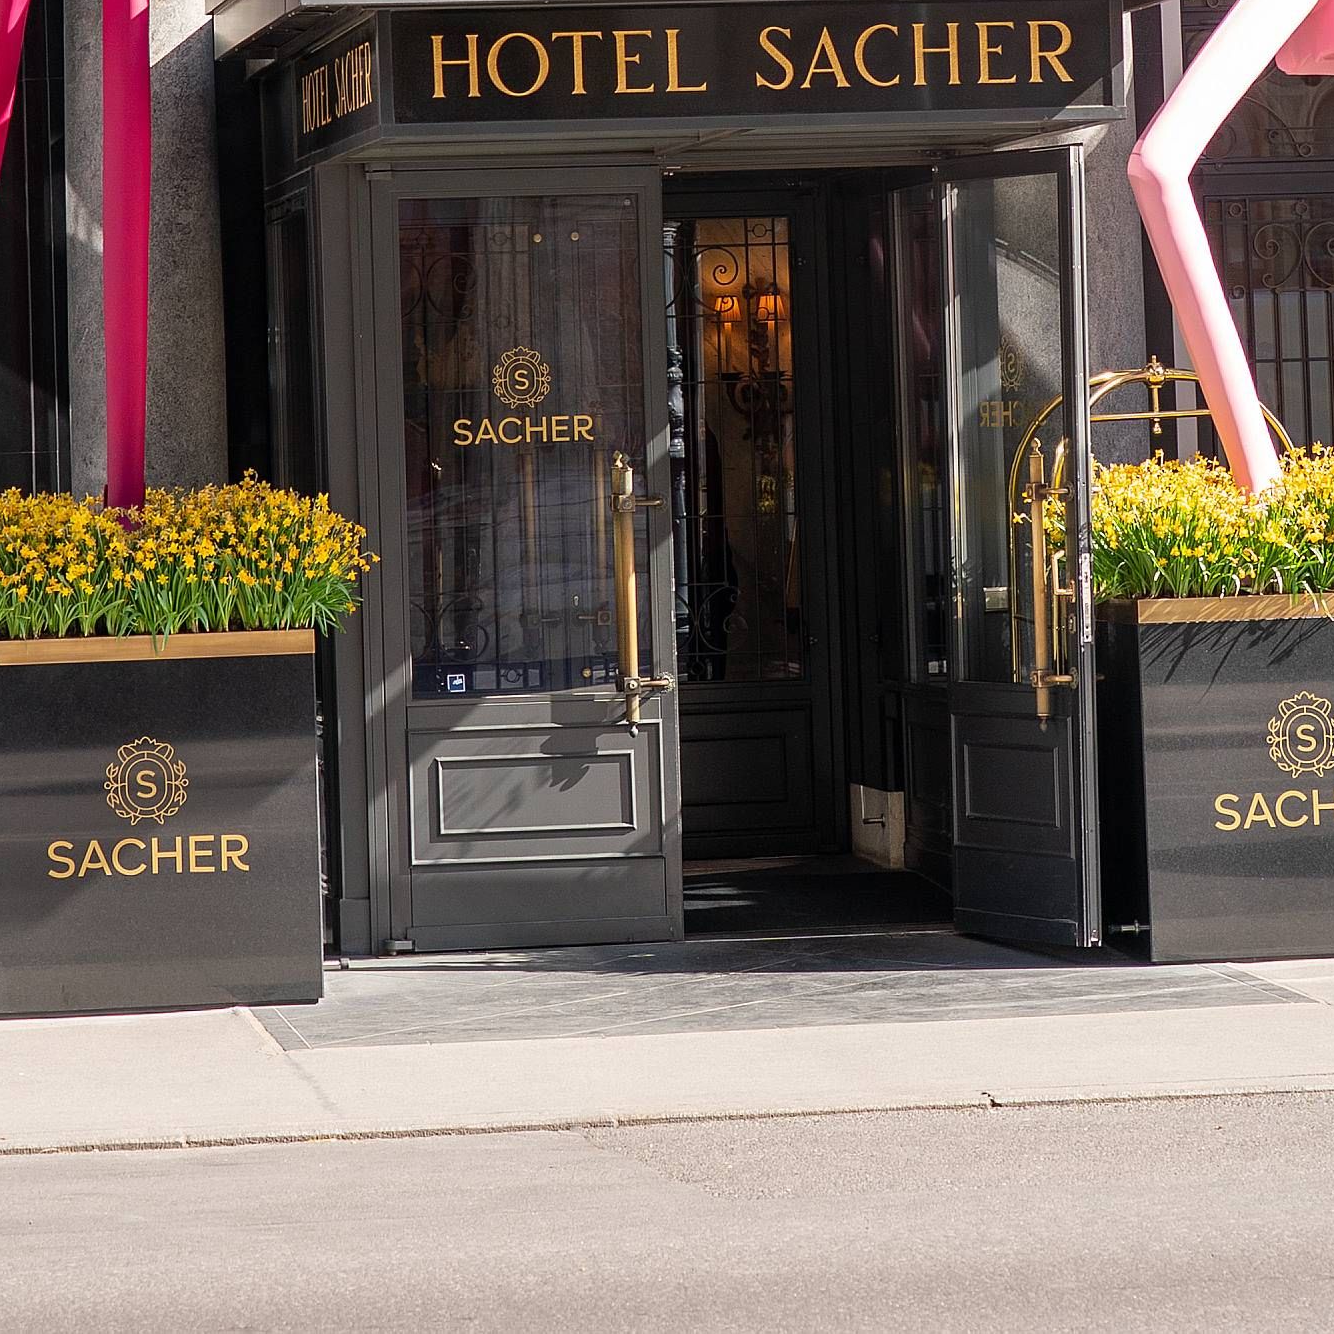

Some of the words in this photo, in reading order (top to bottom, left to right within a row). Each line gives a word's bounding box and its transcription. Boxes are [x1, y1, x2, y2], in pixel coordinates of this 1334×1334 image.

[430, 28, 708, 99] HOTEL
[754, 19, 1075, 91] SACHER
[301, 64, 332, 134] HOTEL
[334, 41, 373, 119] SACHER
[514, 369, 529, 390] S
[452, 414, 595, 446] SACHER
[1295, 724, 1317, 752] S
[135, 769, 158, 798] S
[46, 833, 250, 879] SACHER
